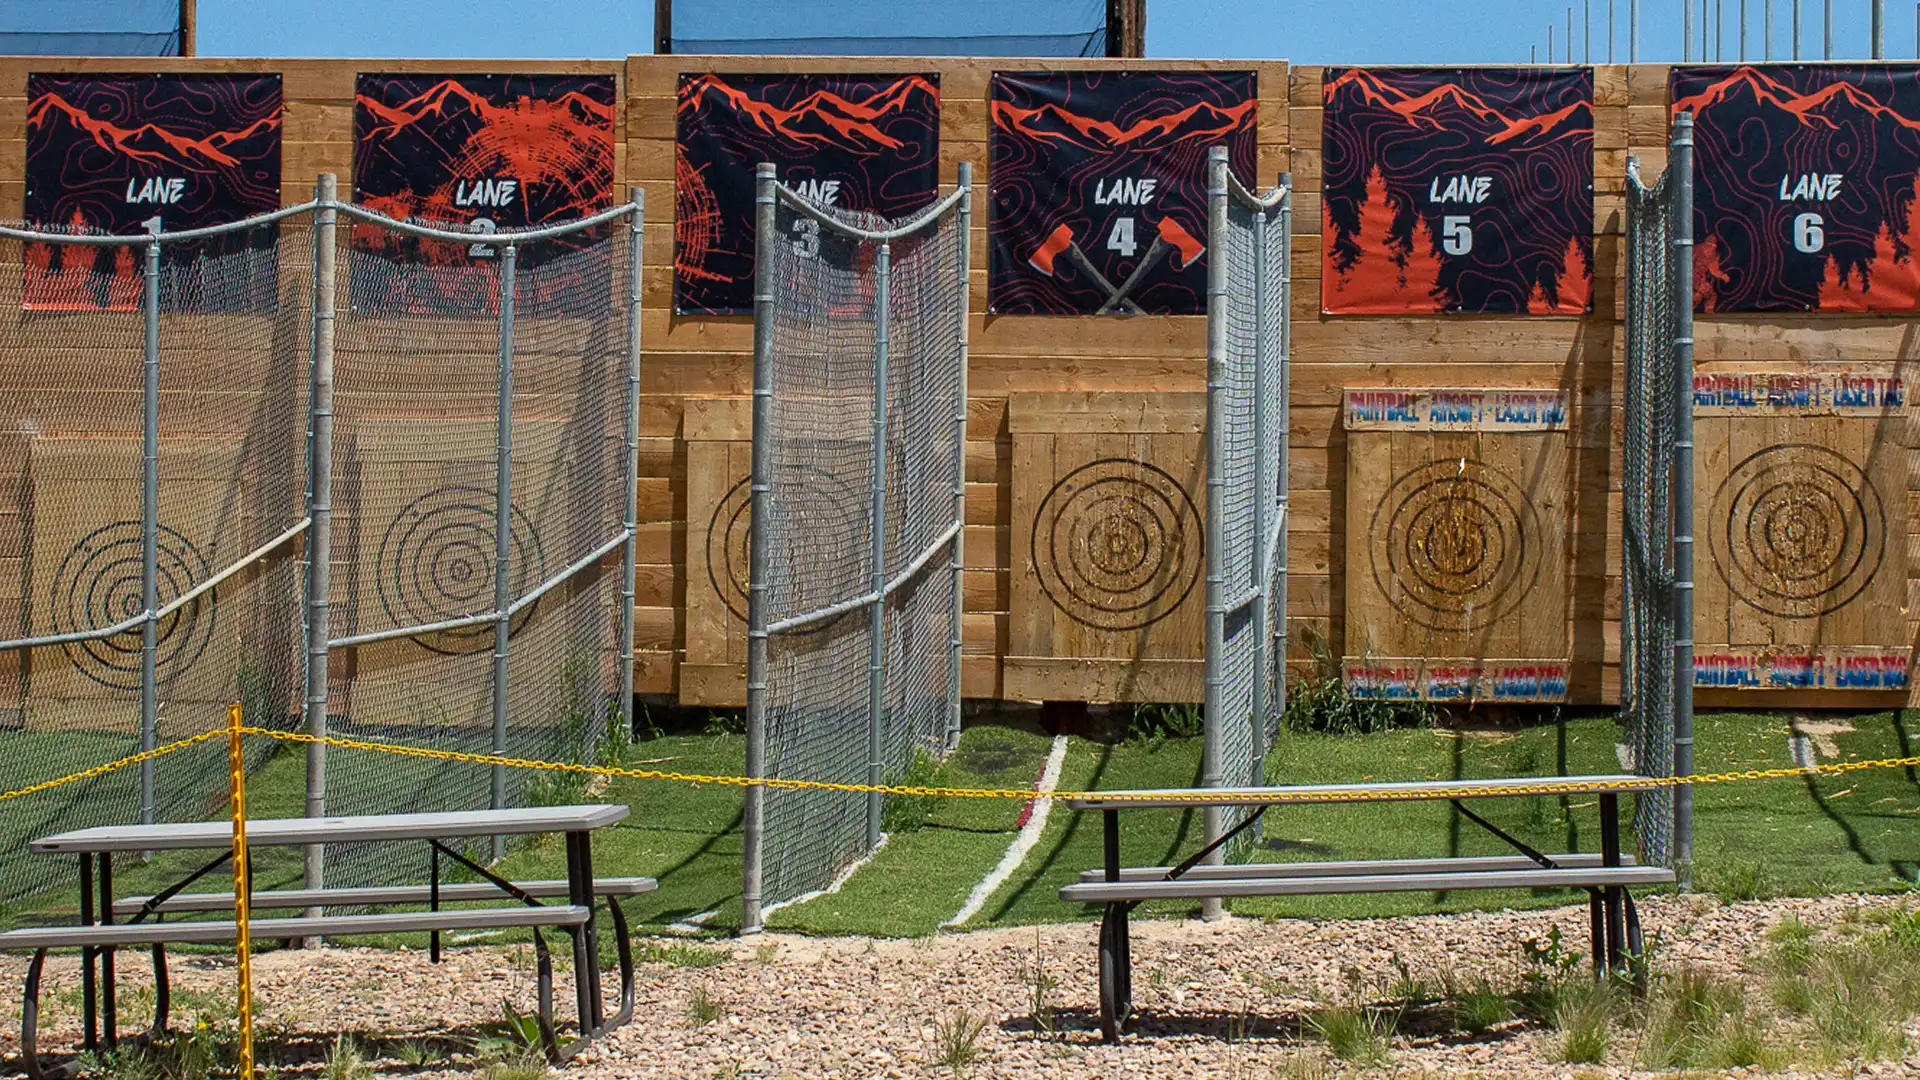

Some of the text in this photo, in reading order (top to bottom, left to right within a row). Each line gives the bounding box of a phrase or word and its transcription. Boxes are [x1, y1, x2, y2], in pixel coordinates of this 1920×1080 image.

[126, 176, 186, 204] LANE
[456, 178, 517, 207] LANE
[1095, 176, 1157, 205] LANE
[1430, 174, 1493, 204] LANE
[1780, 172, 1843, 201] LANE
[792, 218, 820, 258] 3
[1107, 217, 1137, 256] 4
[1443, 215, 1472, 255] 5
[1794, 212, 1824, 253] 6
[1693, 376, 1756, 406] AINTBALL
[1833, 378, 1875, 407] LASER
[1693, 655, 1760, 686] AINTBALL
